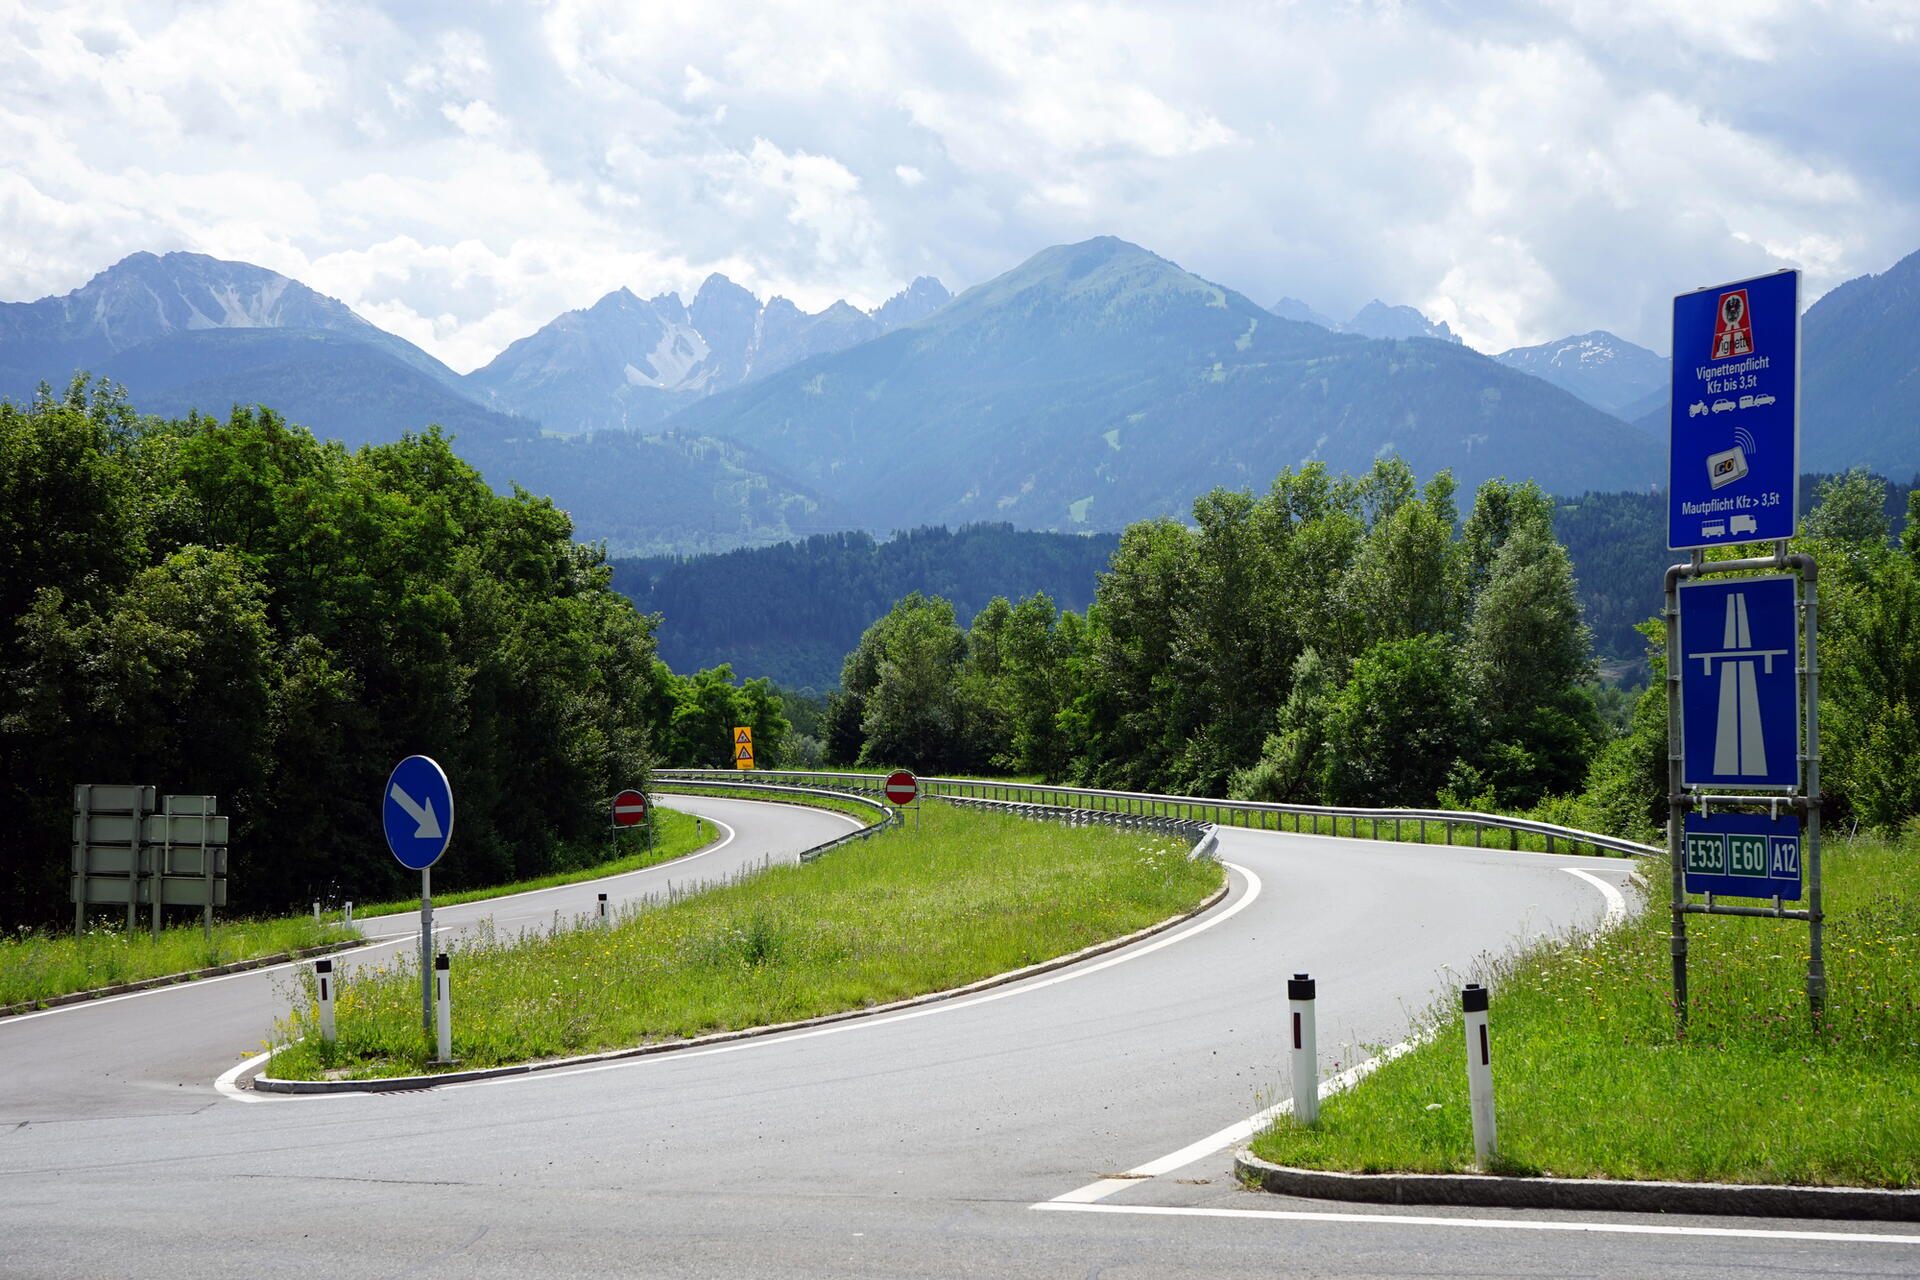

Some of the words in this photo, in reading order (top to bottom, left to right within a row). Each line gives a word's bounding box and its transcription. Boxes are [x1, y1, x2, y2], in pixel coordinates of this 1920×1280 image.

[1696, 356, 1769, 381] Vignettenpflicht
[1707, 379, 1722, 394] Kfz
[1723, 378, 1738, 391] bis
[1739, 375, 1757, 389] 3,5t
[1682, 498, 1734, 515] Mautpflicht
[1736, 495, 1751, 509] Kfz
[1761, 492, 1780, 507] 3,5t
[1688, 839, 1724, 869] E533
[1731, 841, 1764, 871] E60
[1773, 843, 1797, 873] A12
